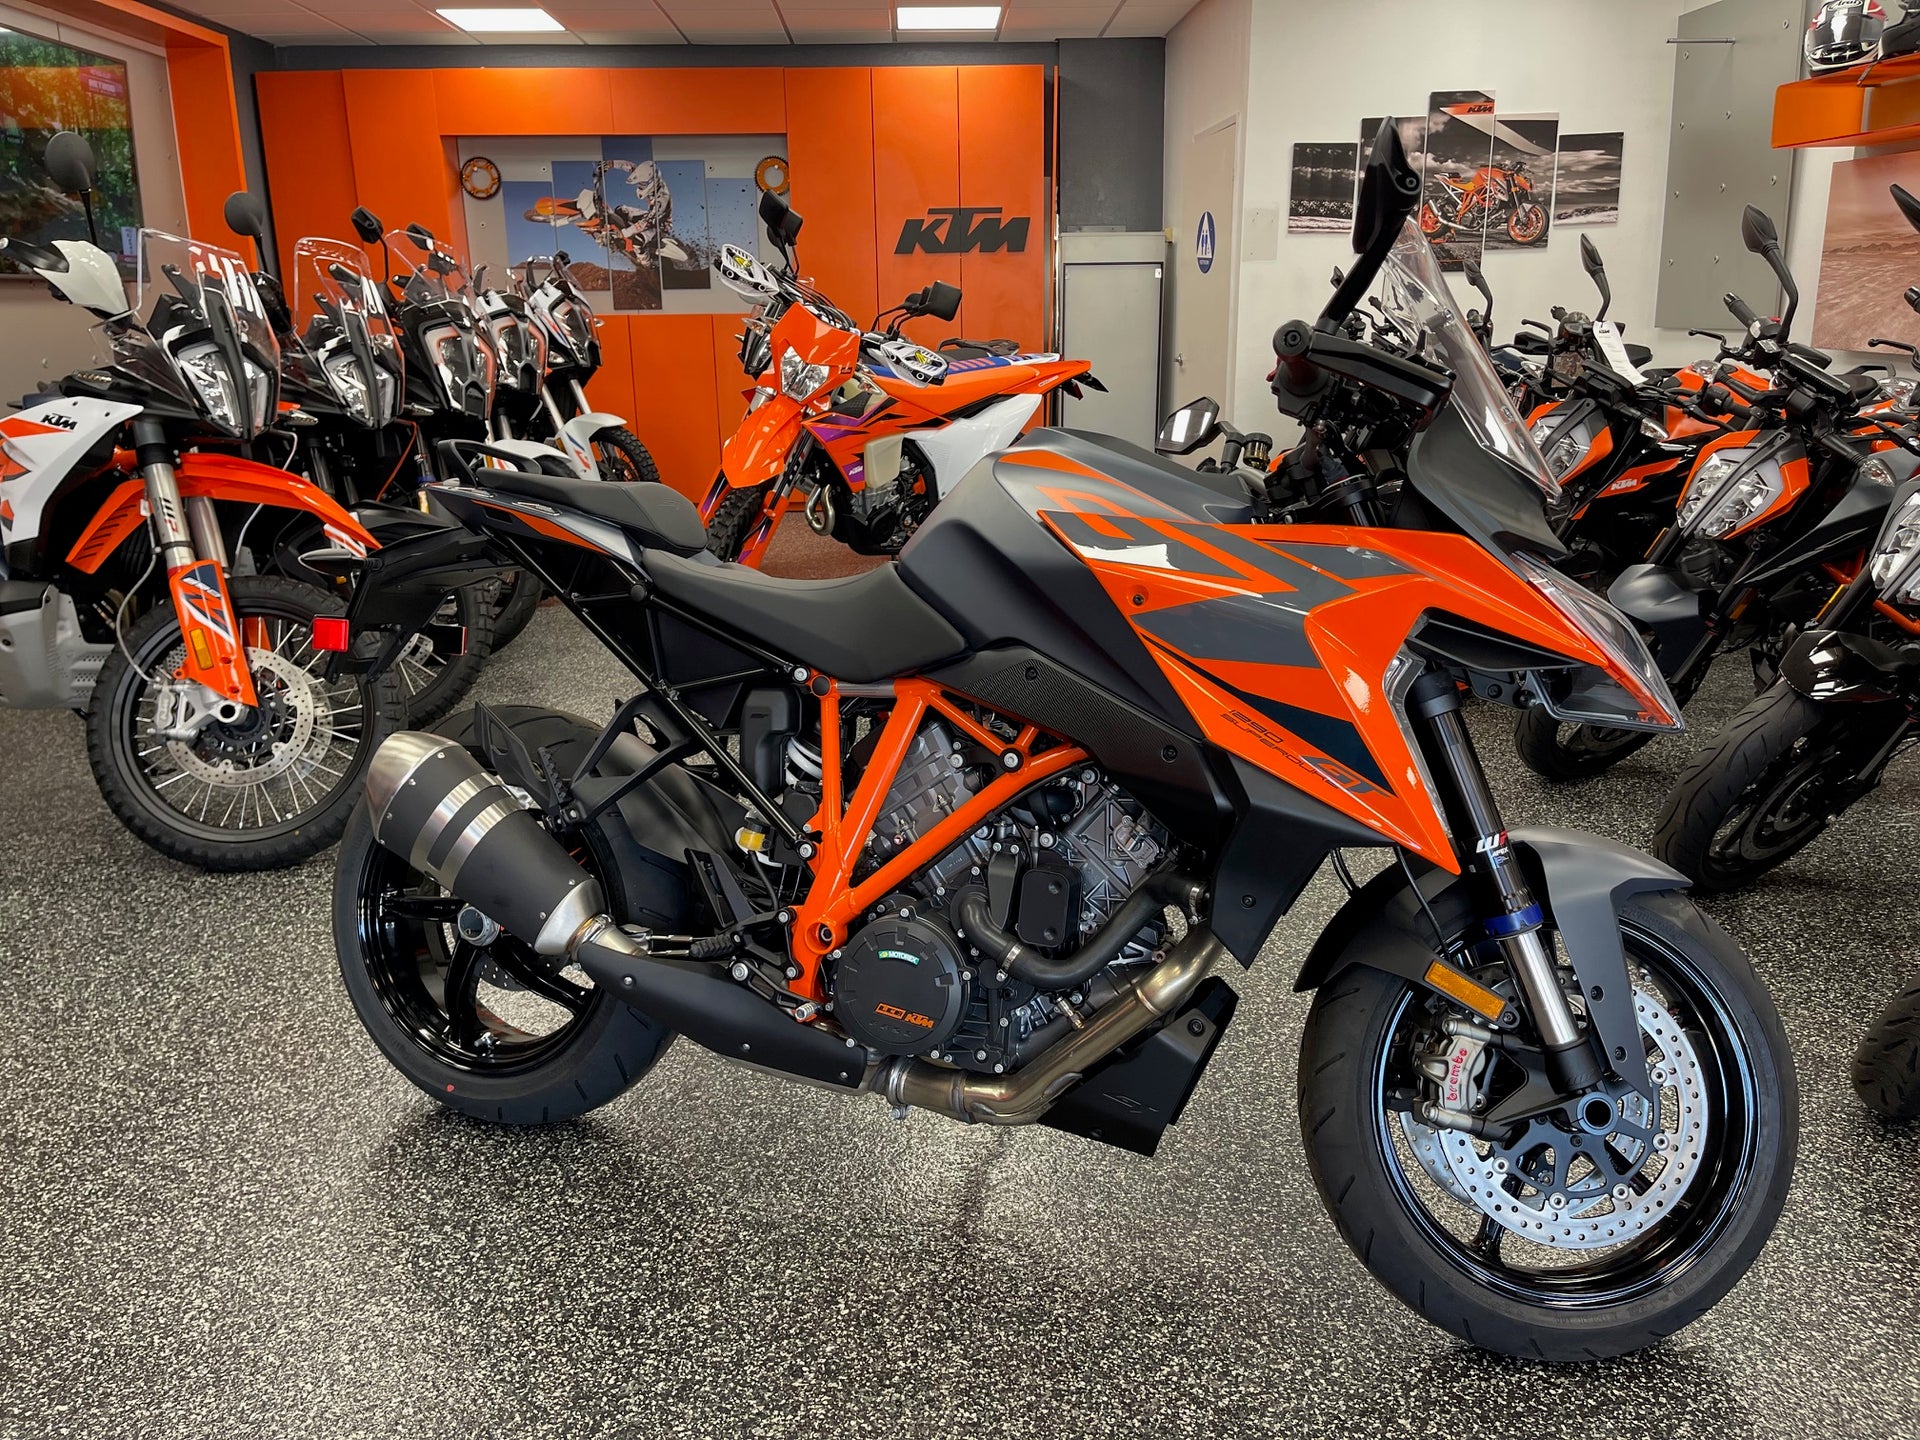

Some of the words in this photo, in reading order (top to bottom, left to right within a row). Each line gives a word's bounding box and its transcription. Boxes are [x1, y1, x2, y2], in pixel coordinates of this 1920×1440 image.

[894, 207, 1031, 254] KTM
[40, 412, 78, 430] KTM
[1611, 479, 1638, 491] KTM
[888, 950, 917, 964] MOTOREX
[905, 1012, 934, 1028] KTM
[1446, 1048, 1468, 1101] brembo
